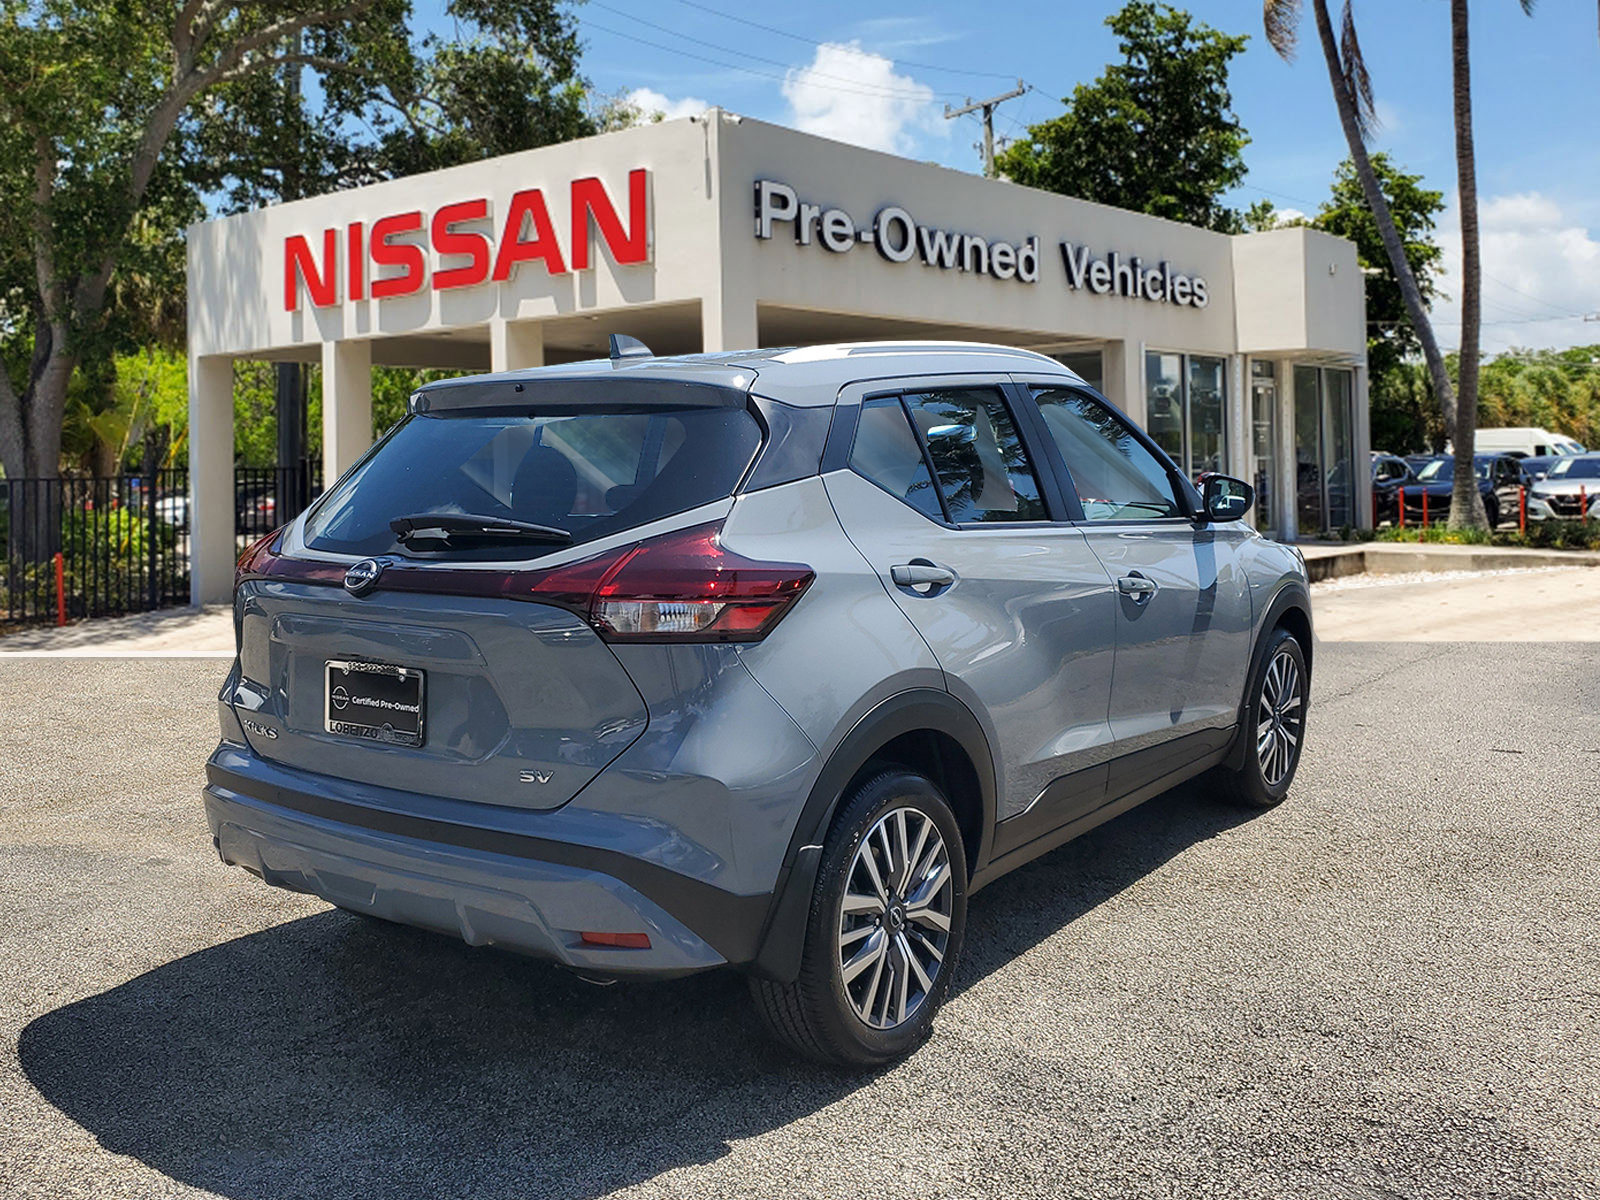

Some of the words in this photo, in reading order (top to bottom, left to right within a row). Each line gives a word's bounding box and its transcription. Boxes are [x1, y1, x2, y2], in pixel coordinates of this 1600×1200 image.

[284, 168, 649, 312] NISSAN
[753, 179, 1040, 285] Pre-Owned
[1060, 240, 1210, 310] Vehicles
[351, 696, 380, 708] Certified
[380, 700, 419, 713] Pre-Owned
[243, 719, 279, 740] KICKS
[519, 769, 555, 784] SV
